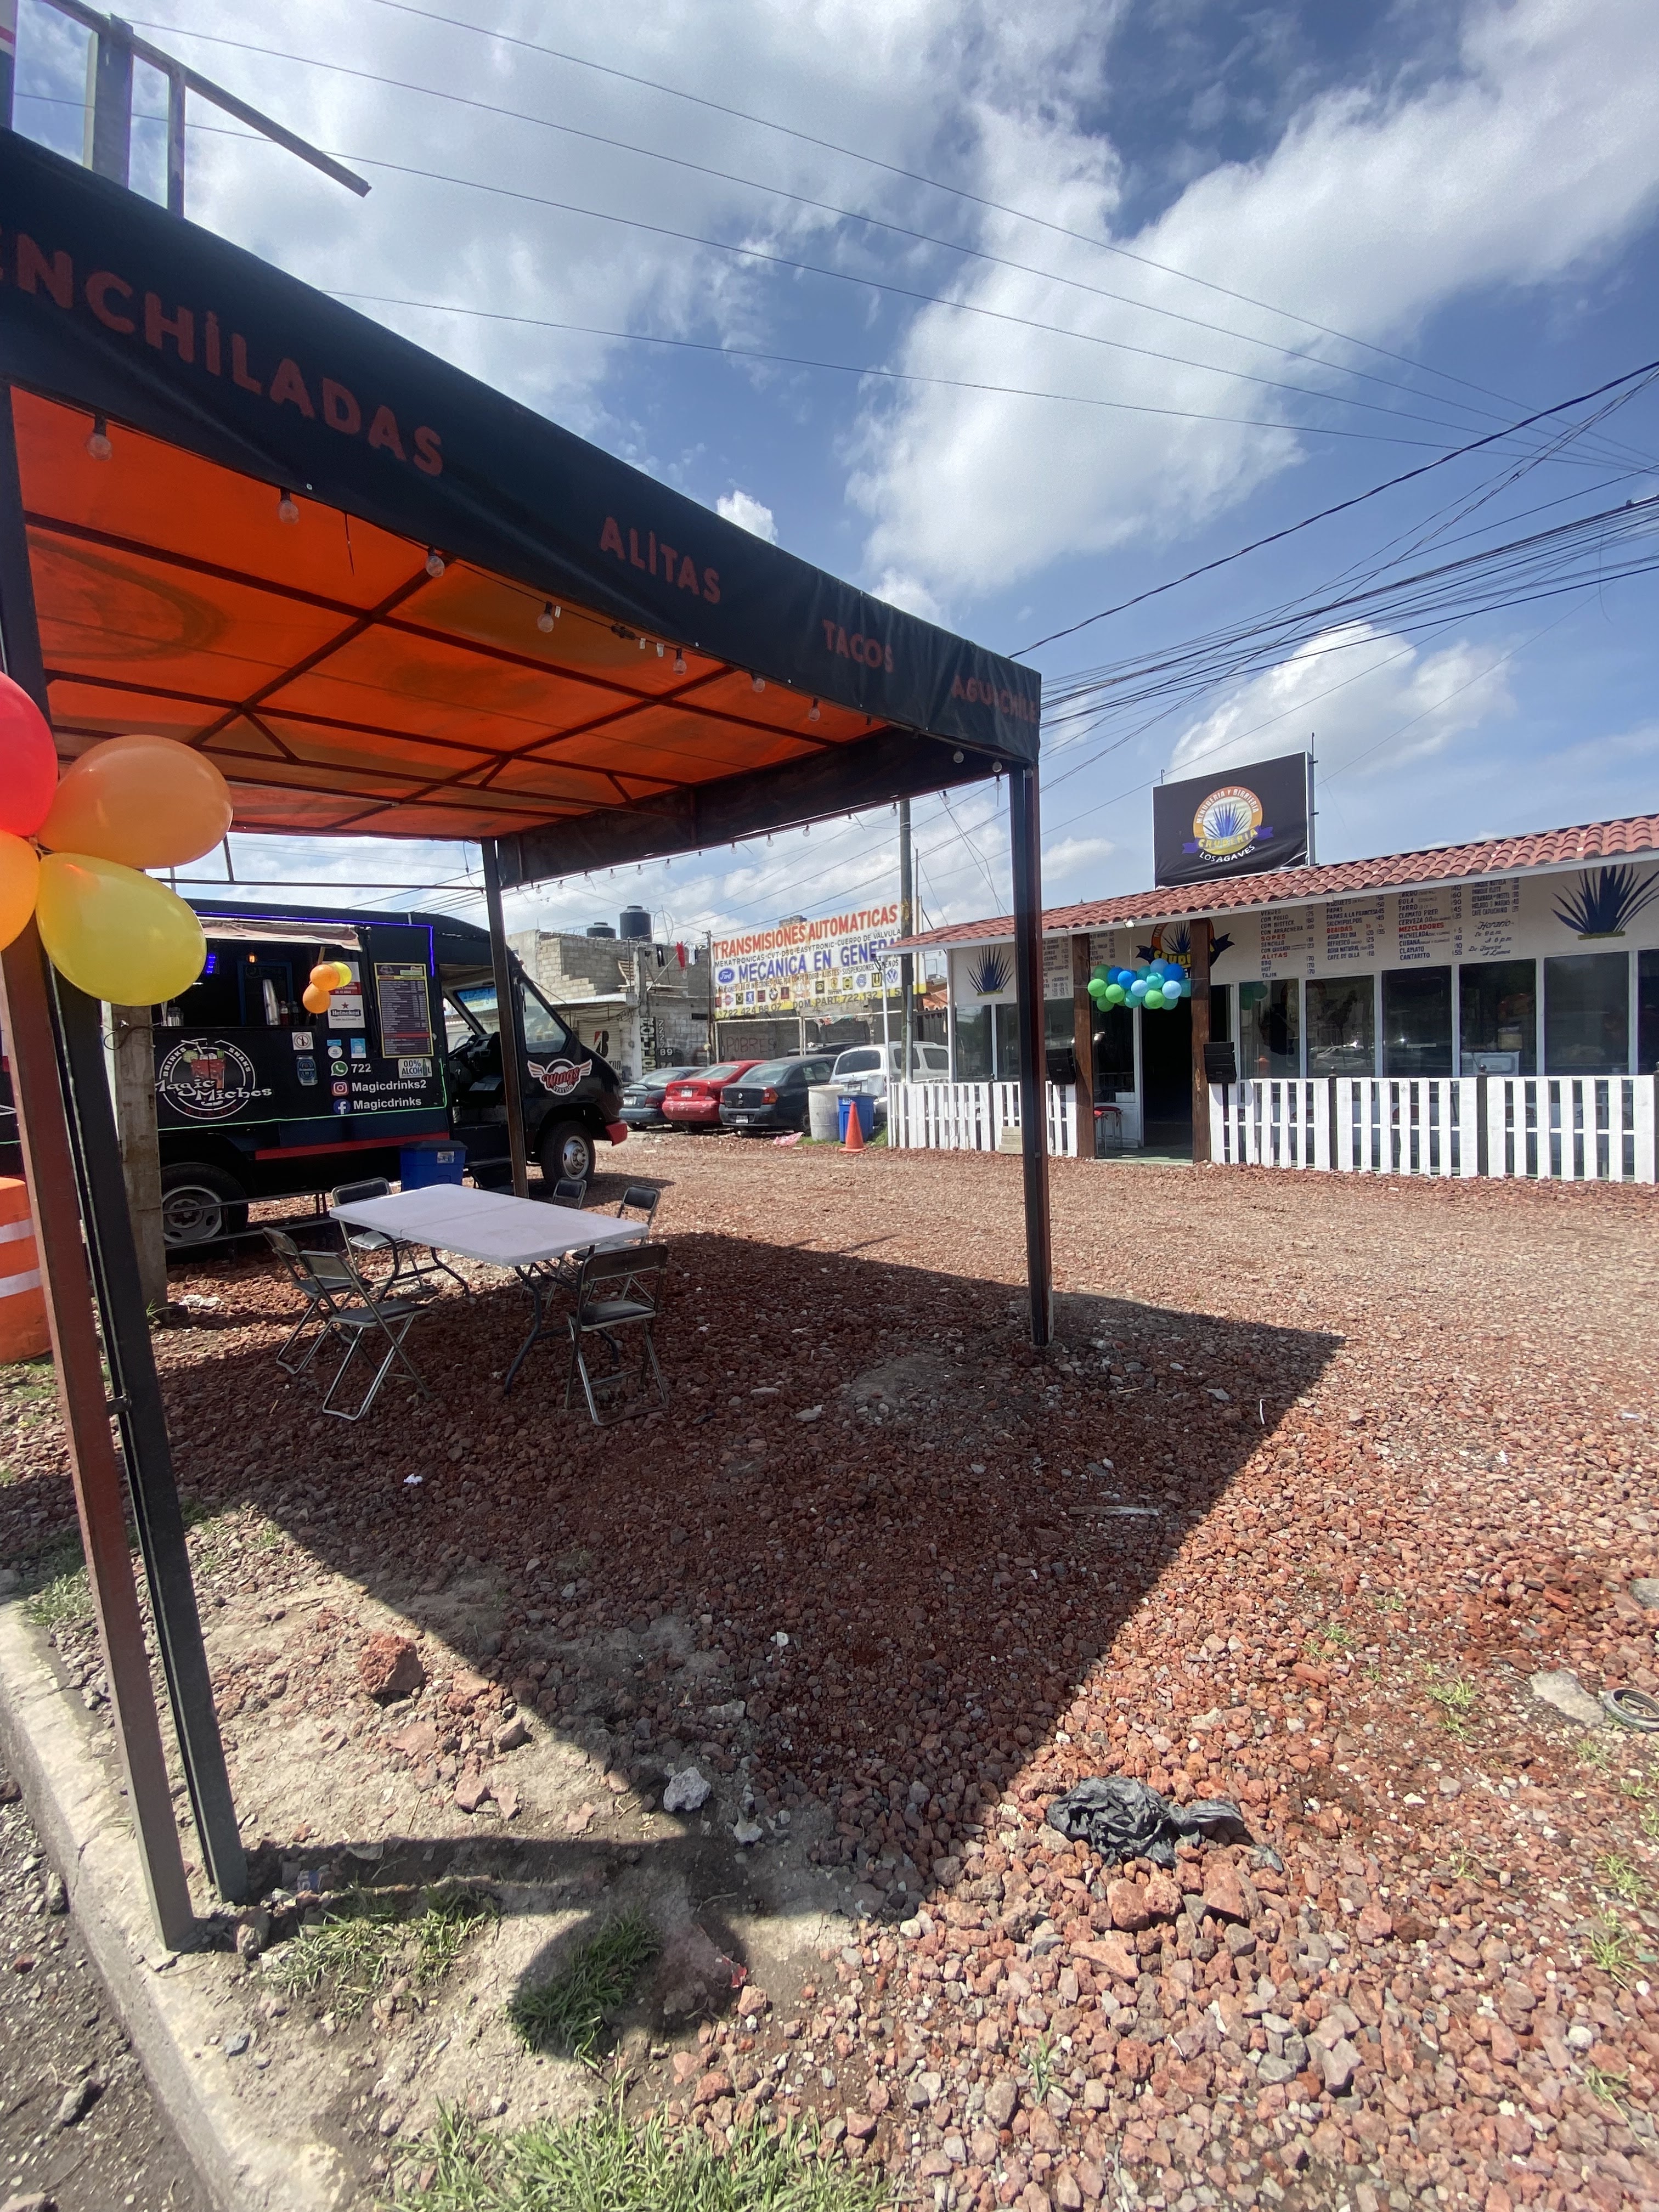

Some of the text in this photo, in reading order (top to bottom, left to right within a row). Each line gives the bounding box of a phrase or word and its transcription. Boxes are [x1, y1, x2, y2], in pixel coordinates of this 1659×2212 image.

[0, 234, 443, 476] NCHILADAS
[600, 516, 721, 603] ALITAS
[822, 619, 894, 673] TACOS
[1196, 791, 1225, 823] MENUDERIA
[1233, 788, 1259, 813] BIRRIERIA
[1198, 828, 1258, 848] CRUDERIA
[1199, 844, 1255, 862] LOS AGAVES
[1398, 917, 1423, 926] CERVEZA
[1398, 922, 1444, 932] MEZCLADORES
[714, 904, 898, 960] TRANSMISIONES AUTOMATICAS
[1399, 931, 1428, 939] MICHELADA
[838, 936, 861, 946] CUERPO
[739, 954, 806, 983] MECANICA
[814, 949, 832, 972] EN
[842, 964, 874, 975] SUSPENSIONES
[726, 1037, 776, 1053] POBRES
[163, 1047, 187, 1077] DRINKS
[228, 1047, 251, 1073] SNAKS
[351, 1063, 371, 1073] 722
[352, 1080, 427, 1093] Magicdrinks2
[552, 1084, 574, 1093] STATION
[195, 1087, 272, 1101] Miches
[353, 1097, 422, 1110] Magicdrinks
